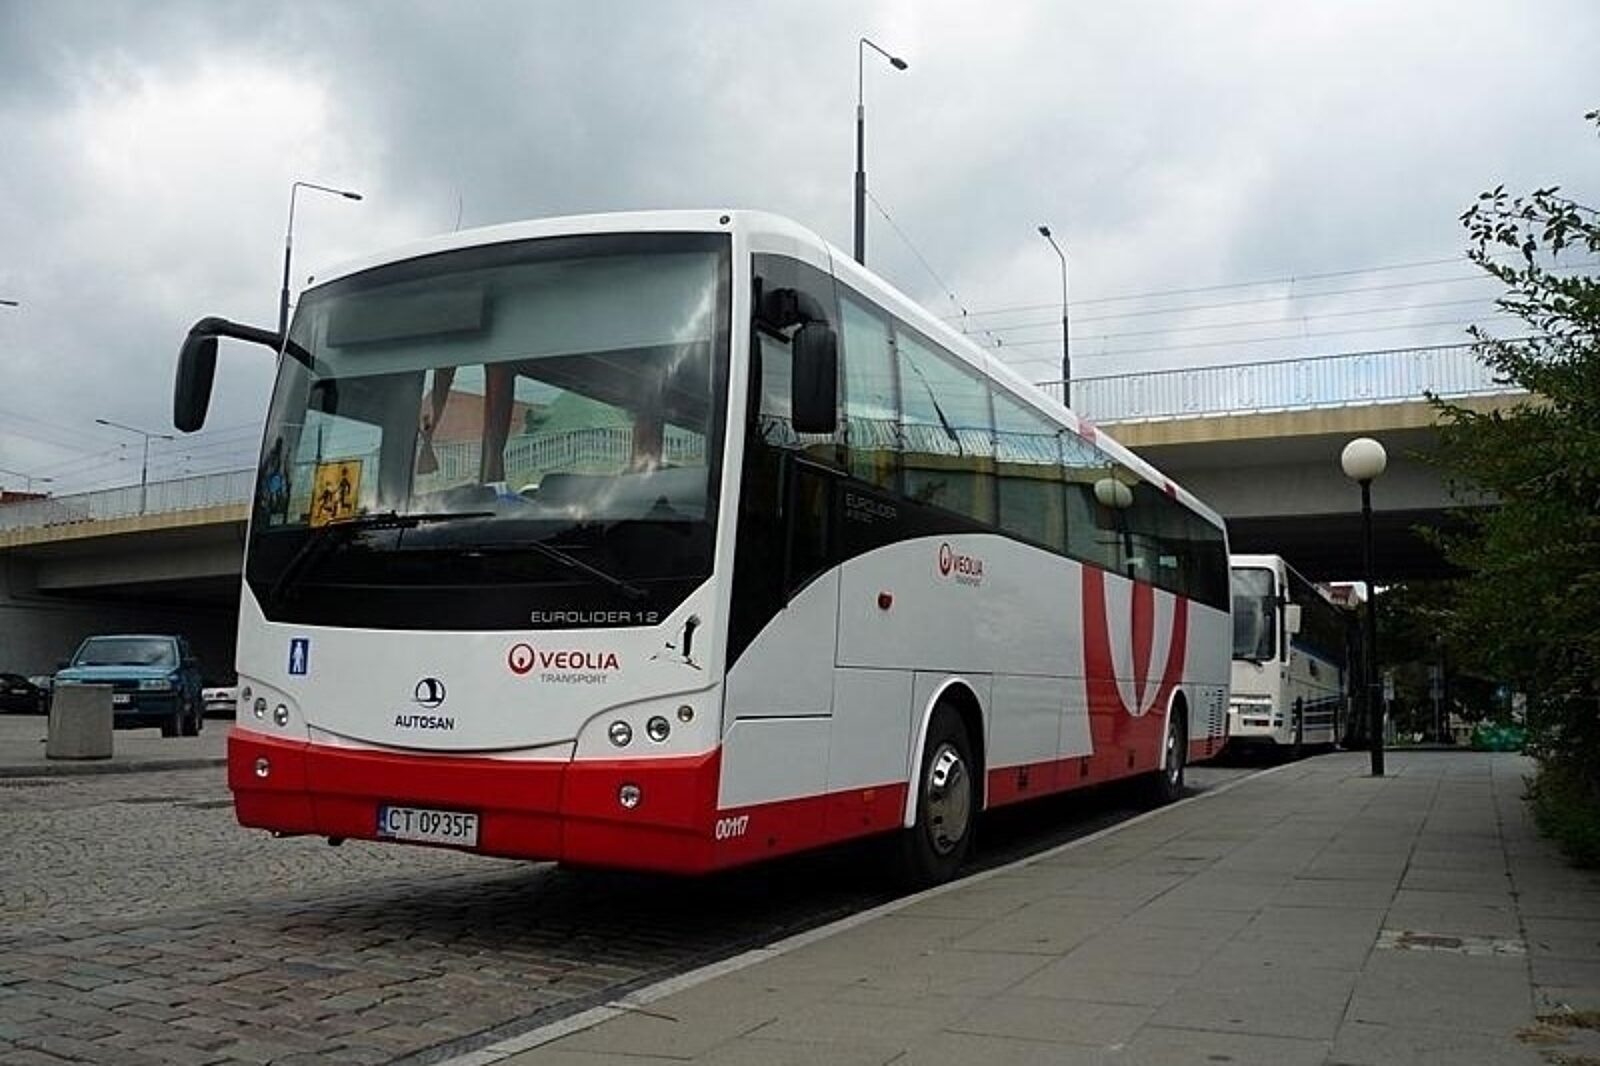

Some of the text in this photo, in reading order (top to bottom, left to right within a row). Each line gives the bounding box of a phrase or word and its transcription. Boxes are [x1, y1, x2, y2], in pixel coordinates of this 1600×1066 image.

[531, 611, 659, 623] EUROLIDER 12
[540, 651, 620, 670] VEOLIA
[540, 673, 607, 685] TRANSPORT
[395, 715, 455, 730] AUTOSAN
[389, 809, 475, 837] CT 0935F
